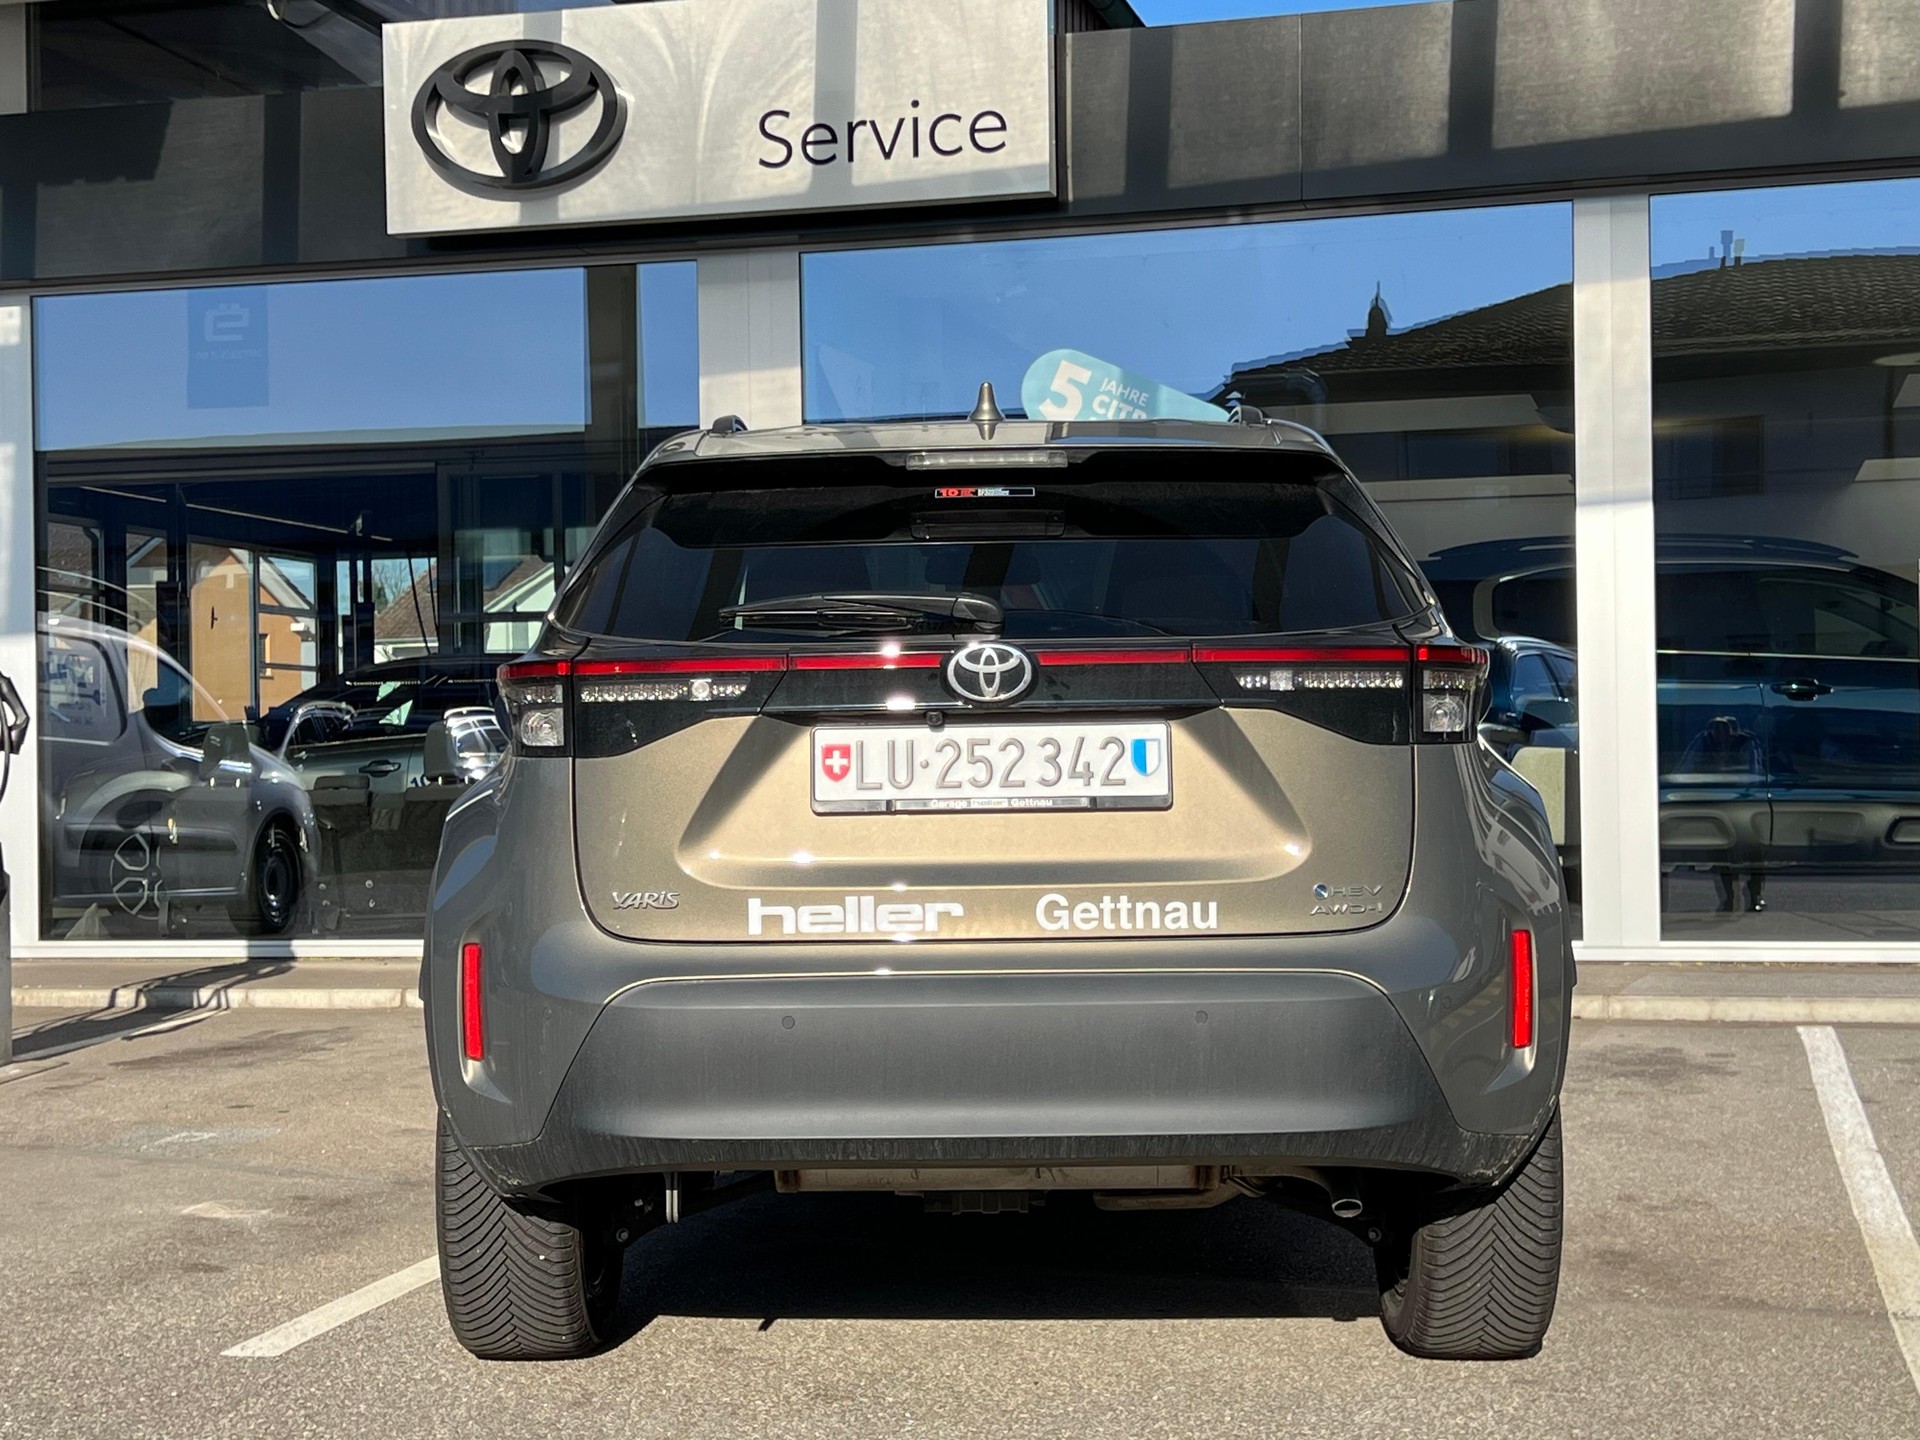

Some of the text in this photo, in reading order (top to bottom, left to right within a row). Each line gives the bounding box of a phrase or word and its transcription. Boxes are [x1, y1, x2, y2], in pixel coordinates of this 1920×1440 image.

[758, 99, 1007, 169] Service
[1039, 360, 1092, 421] 5
[1099, 378, 1149, 407] JAHRE
[748, 895, 964, 935] heller
[1035, 893, 1218, 931] Gettnau
